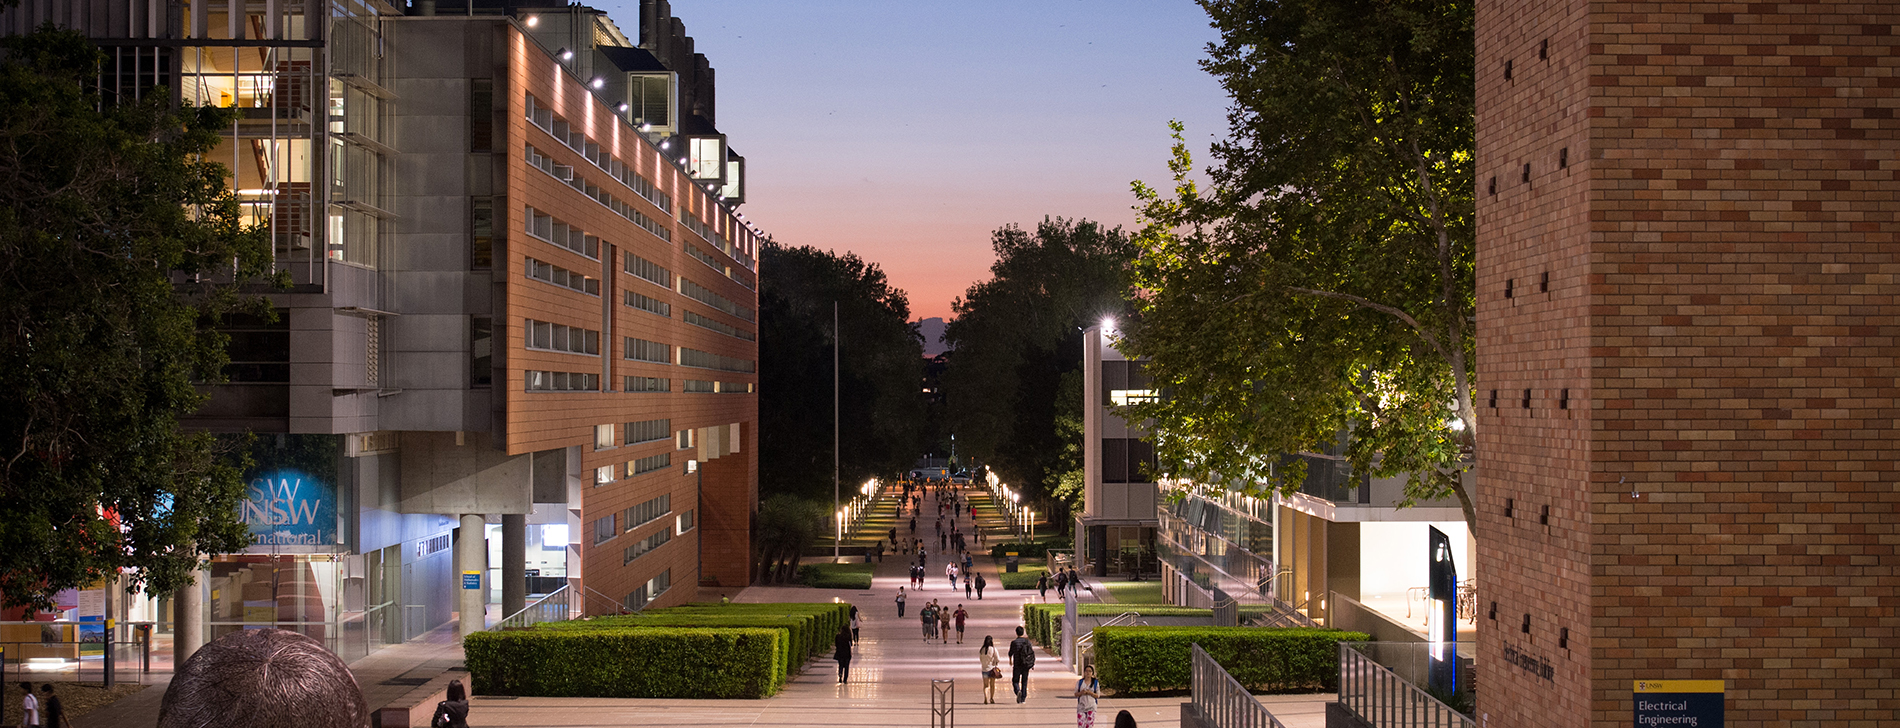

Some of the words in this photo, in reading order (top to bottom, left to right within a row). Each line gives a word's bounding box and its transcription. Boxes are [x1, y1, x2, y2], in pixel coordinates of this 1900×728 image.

[250, 478, 301, 504] SW
[1639, 700, 1687, 711] Electrical
[1639, 714, 1698, 727] Engineering
